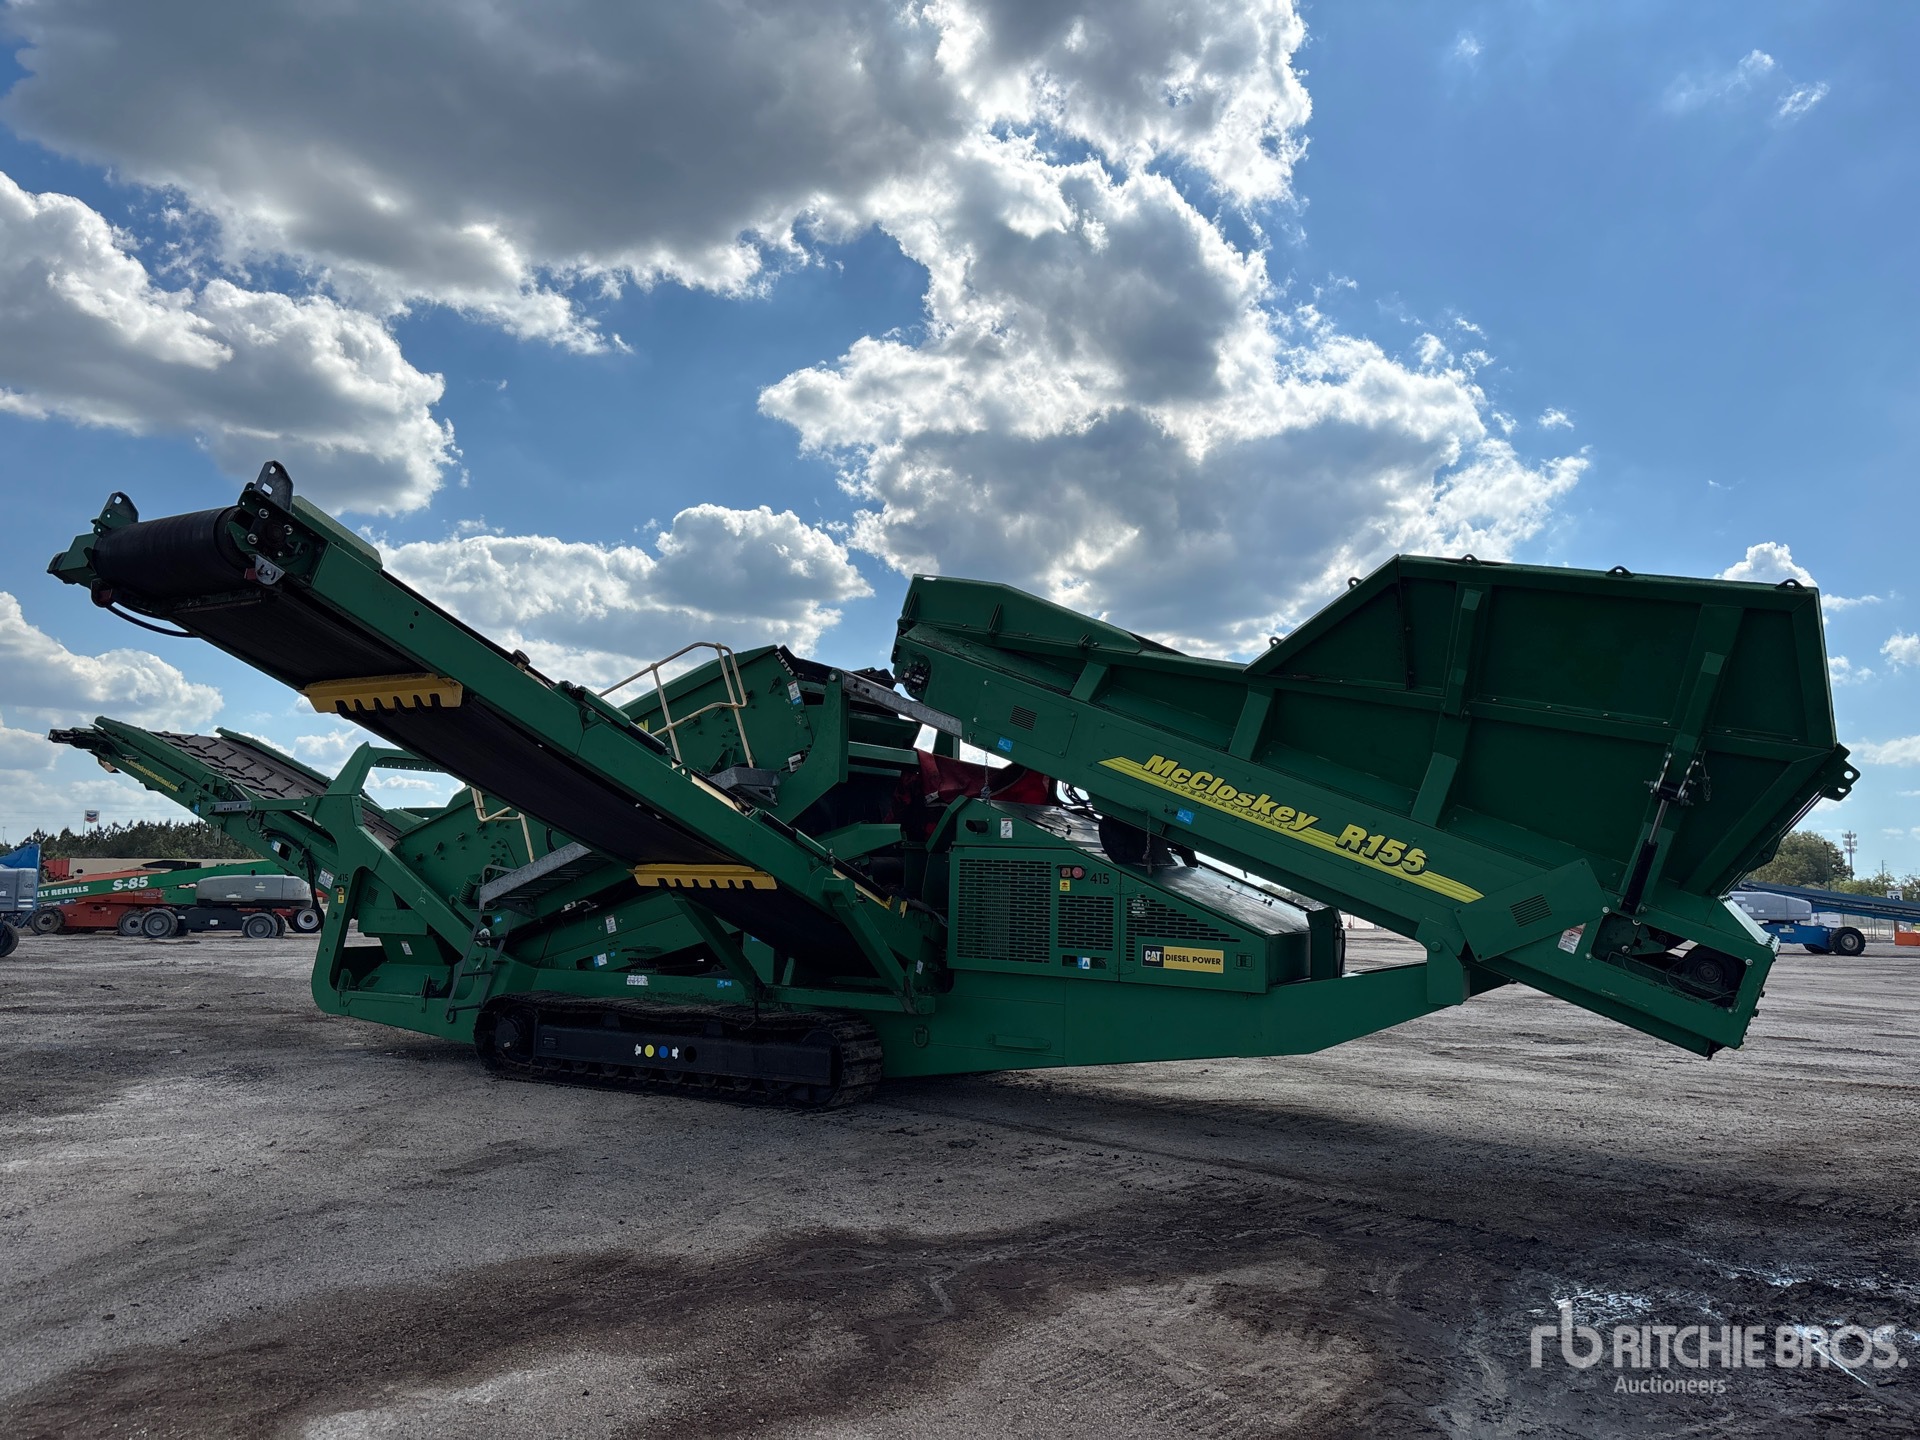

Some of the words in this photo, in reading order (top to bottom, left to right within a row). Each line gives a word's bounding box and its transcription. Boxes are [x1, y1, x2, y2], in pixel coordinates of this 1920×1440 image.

[1162, 779, 1290, 829] INTERNATIONAL
[1142, 754, 1321, 832] McCloskey
[1335, 823, 1431, 875] R155
[112, 876, 149, 891] S-85
[338, 873, 349, 882] 415
[1090, 872, 1110, 885] 415
[50, 885, 89, 896] RENTALS
[1144, 949, 1163, 963] CAT
[1165, 954, 1191, 964] DIESEL
[1192, 956, 1222, 966] POWER
